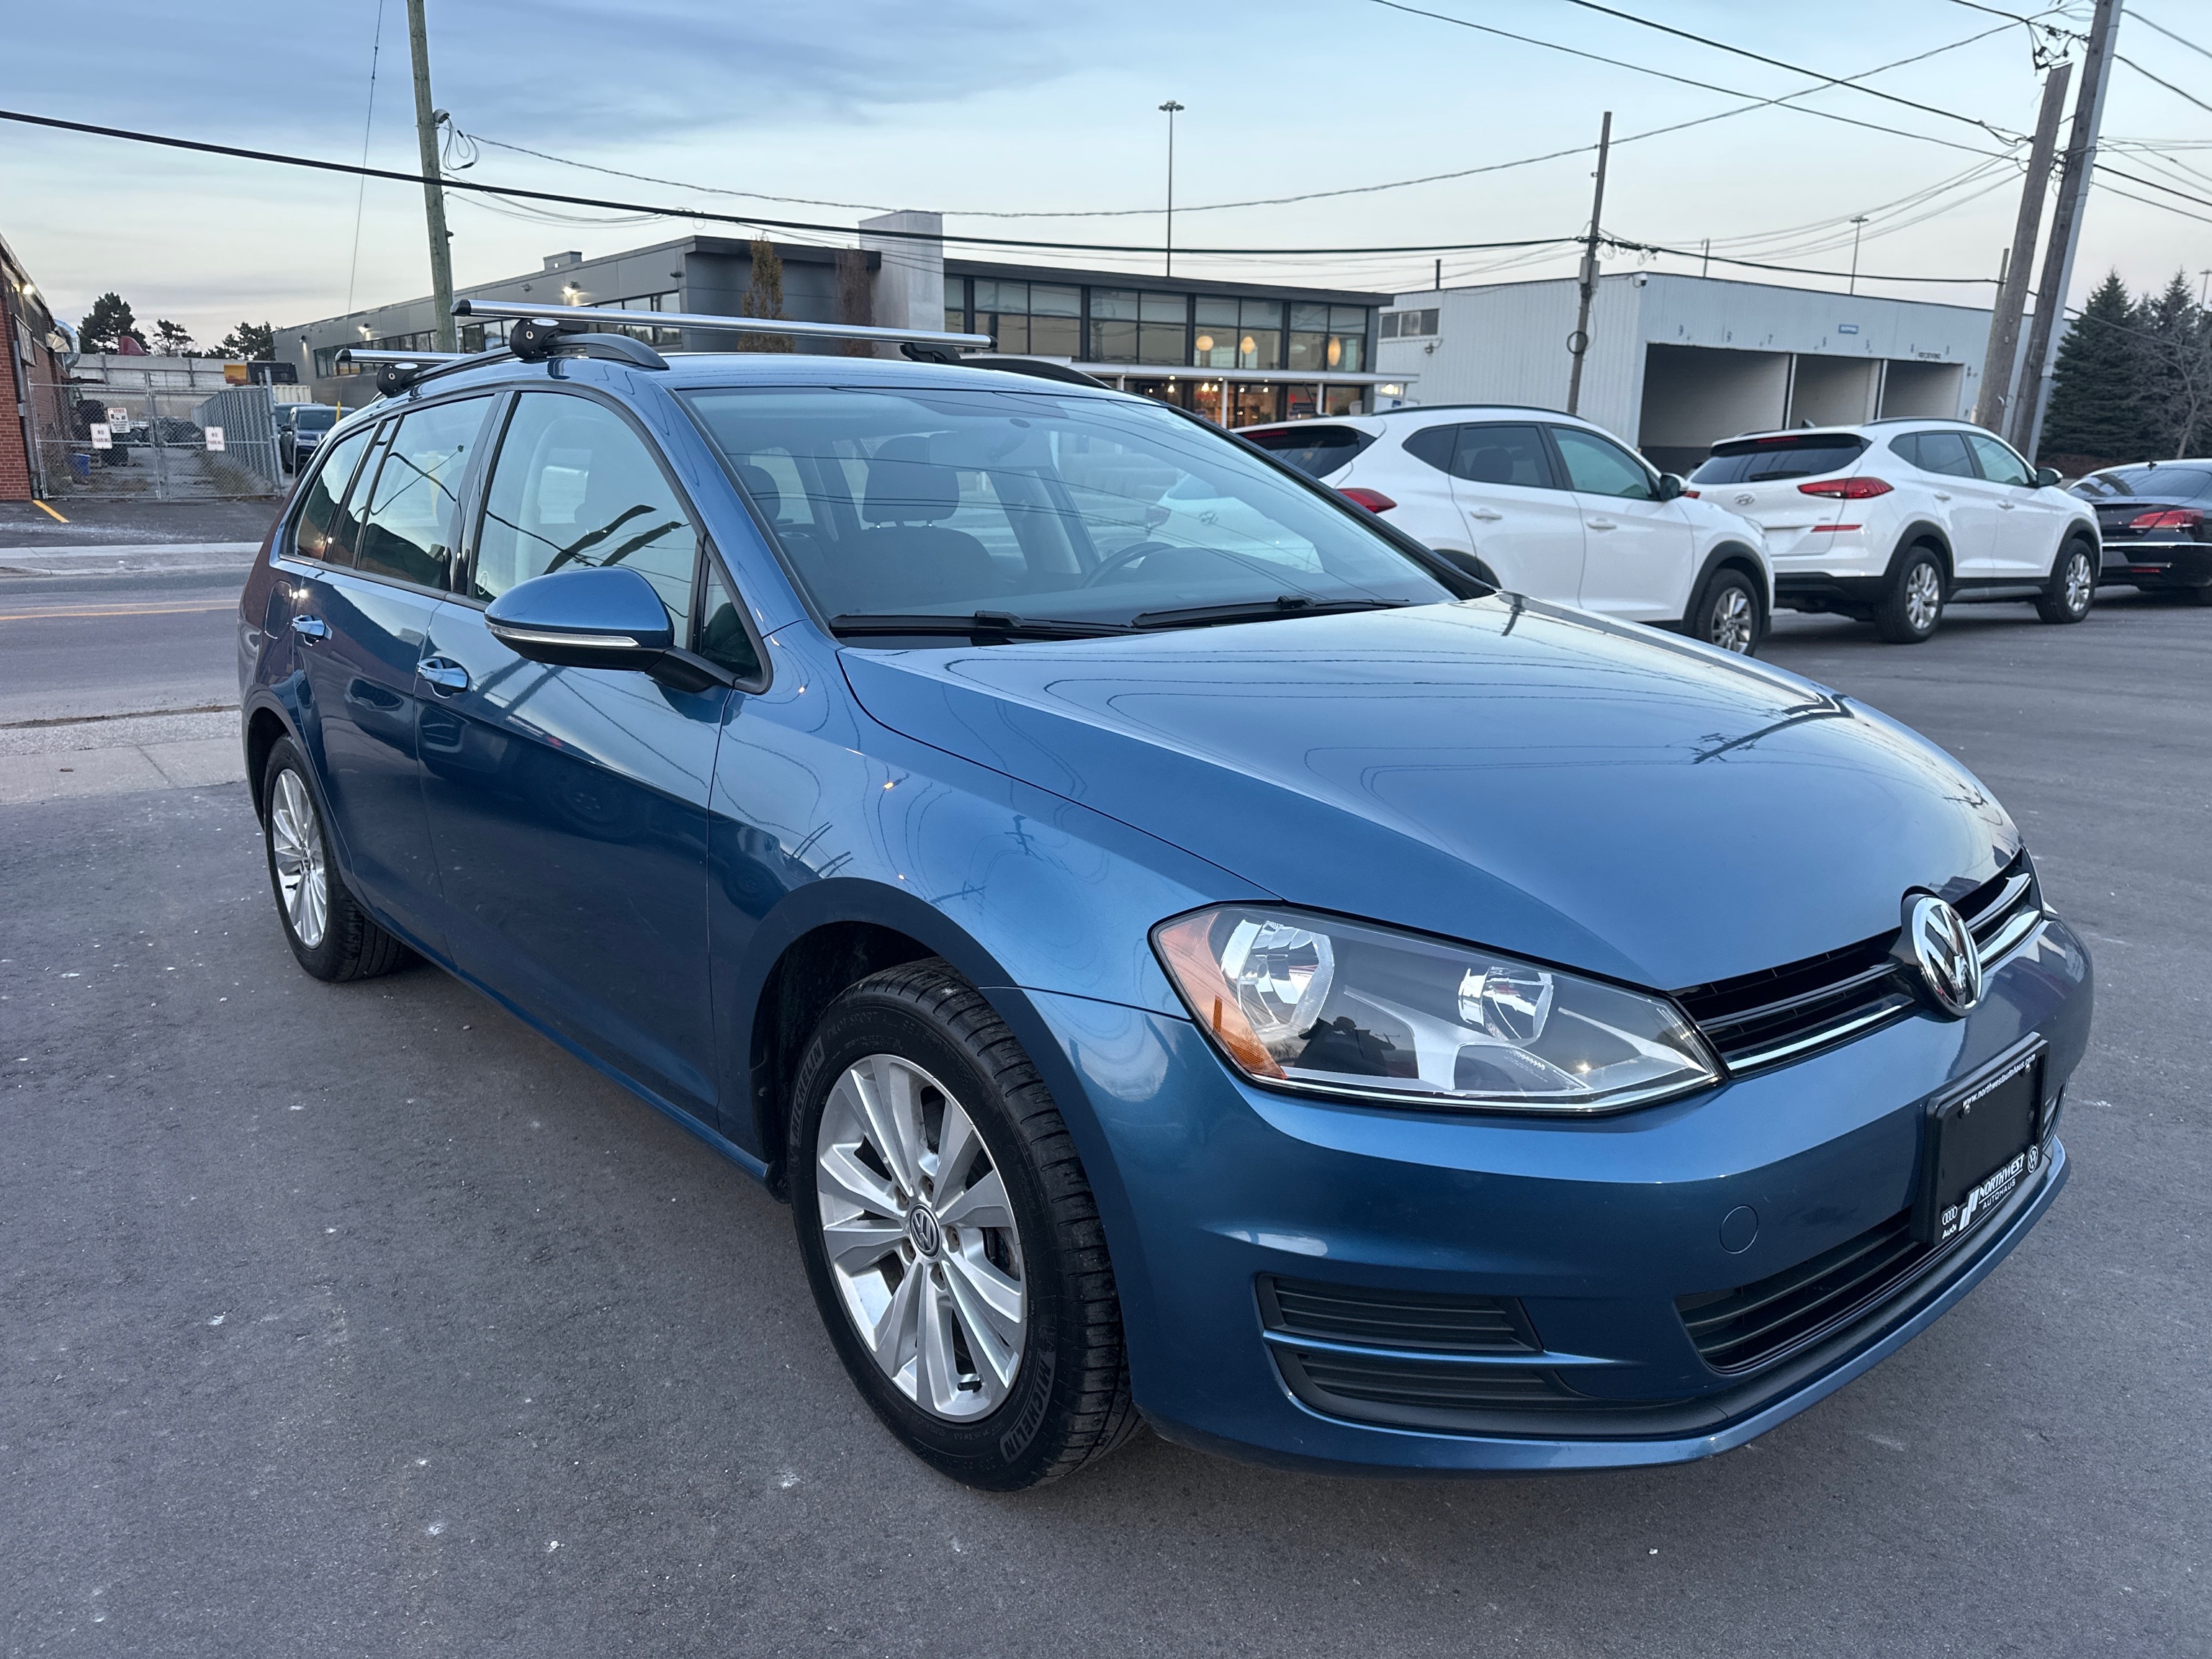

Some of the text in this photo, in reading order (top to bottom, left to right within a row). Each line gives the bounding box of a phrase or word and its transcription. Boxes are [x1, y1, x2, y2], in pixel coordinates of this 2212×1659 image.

[791, 1041, 823, 1139] MICHELIN
[1978, 1154, 2026, 1200] NORTHWEST
[1982, 1178, 2016, 1210] AUTOHAUS
[1942, 1223, 1957, 1240] Audi
[1004, 1357, 1052, 1459] MICHELIN
